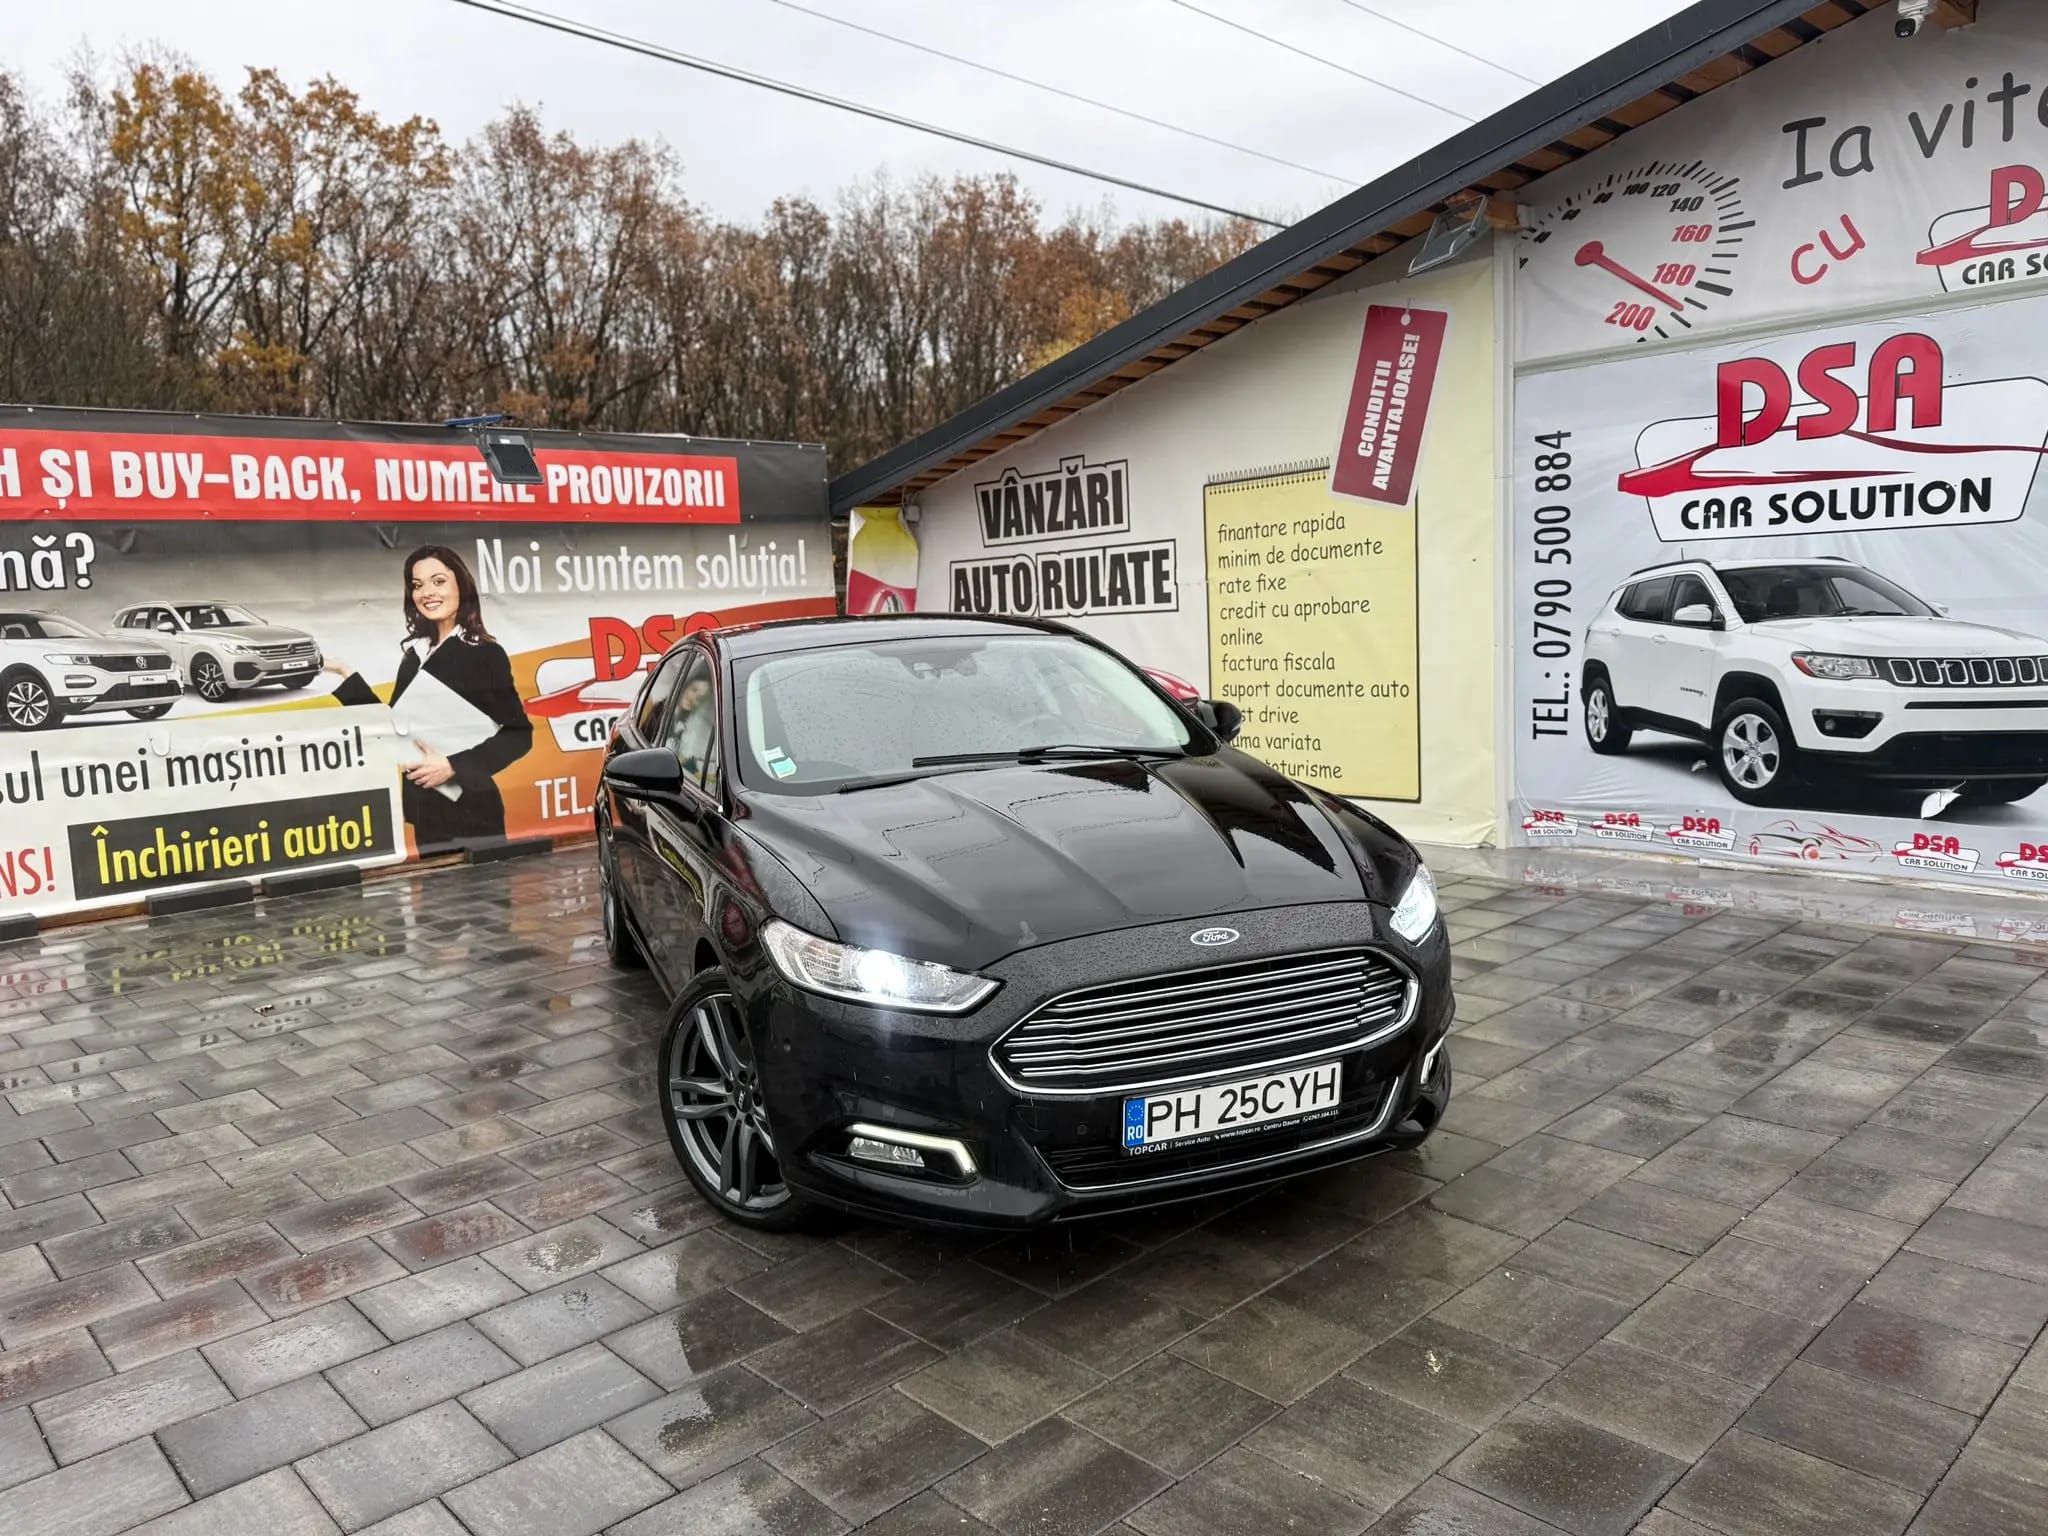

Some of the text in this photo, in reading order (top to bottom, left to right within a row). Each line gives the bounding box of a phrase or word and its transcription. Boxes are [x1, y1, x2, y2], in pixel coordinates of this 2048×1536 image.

[1782, 117, 1874, 189] Ia
[1622, 182, 1650, 197] 100
[1650, 183, 1681, 198] 120
[1669, 196, 1704, 213] 140
[1671, 224, 1713, 243] 160
[1791, 214, 1865, 285] cu
[1651, 263, 1696, 286] 180
[1962, 261, 2015, 285] CAR
[1605, 301, 1656, 332] 200
[1717, 332, 1943, 449] DSA
[1357, 359, 1392, 458] CONDITII
[1372, 333, 1421, 491] AVANTAJOASE!
[1534, 429, 1572, 493] 884
[110, 450, 361, 504] BUY-BACK,
[547, 464, 726, 507] PROVIZORII
[980, 463, 1125, 540] VÂNZĂRI
[1680, 476, 1992, 531] CAR SOLUTION
[1218, 510, 1345, 544] finantare rapida
[1534, 505, 1572, 565] 500
[1218, 537, 1384, 569] minim de documente
[476, 538, 542, 594] Noi
[555, 545, 683, 593] suntem
[954, 548, 1173, 613] AUTO RULATE
[1219, 573, 1287, 595] rate fixe
[1220, 595, 1371, 622] credit cu aprobare
[1533, 578, 1572, 658] 0790
[1220, 628, 1264, 646] online
[1221, 651, 1335, 672] factura fiscala
[1222, 679, 1410, 702] suport documente auto
[1240, 706, 1299, 724] st drive
[1265, 734, 1321, 751] variata
[61, 748, 149, 798] unei
[165, 735, 287, 792] mașini
[300, 726, 366, 772] noi!
[535, 776, 594, 820] TEL.
[1532, 810, 1566, 823] DSA
[1605, 813, 1640, 828] DSA
[1682, 816, 1720, 834] DSA
[1529, 827, 1573, 836] CAR SOLUTION
[1600, 830, 1648, 841] CAR SOLUTION
[1677, 838, 1729, 849] CAR SOLUTION
[90, 805, 374, 885] Închirieri auto!
[1913, 833, 1960, 855] DSA
[1904, 858, 1968, 871] CAR SOLUTION
[2010, 869, 2028, 877] CAR
[1202, 930, 1228, 943] Ford
[1147, 1067, 1336, 1138] PH 25CYH
[1127, 1124, 1143, 1141] RO
[1129, 1142, 1168, 1156] TOPCAR
[1174, 1138, 1196, 1148] Service
[1196, 1135, 1211, 1143] Auto
[1263, 1121, 1281, 1131] Centru
